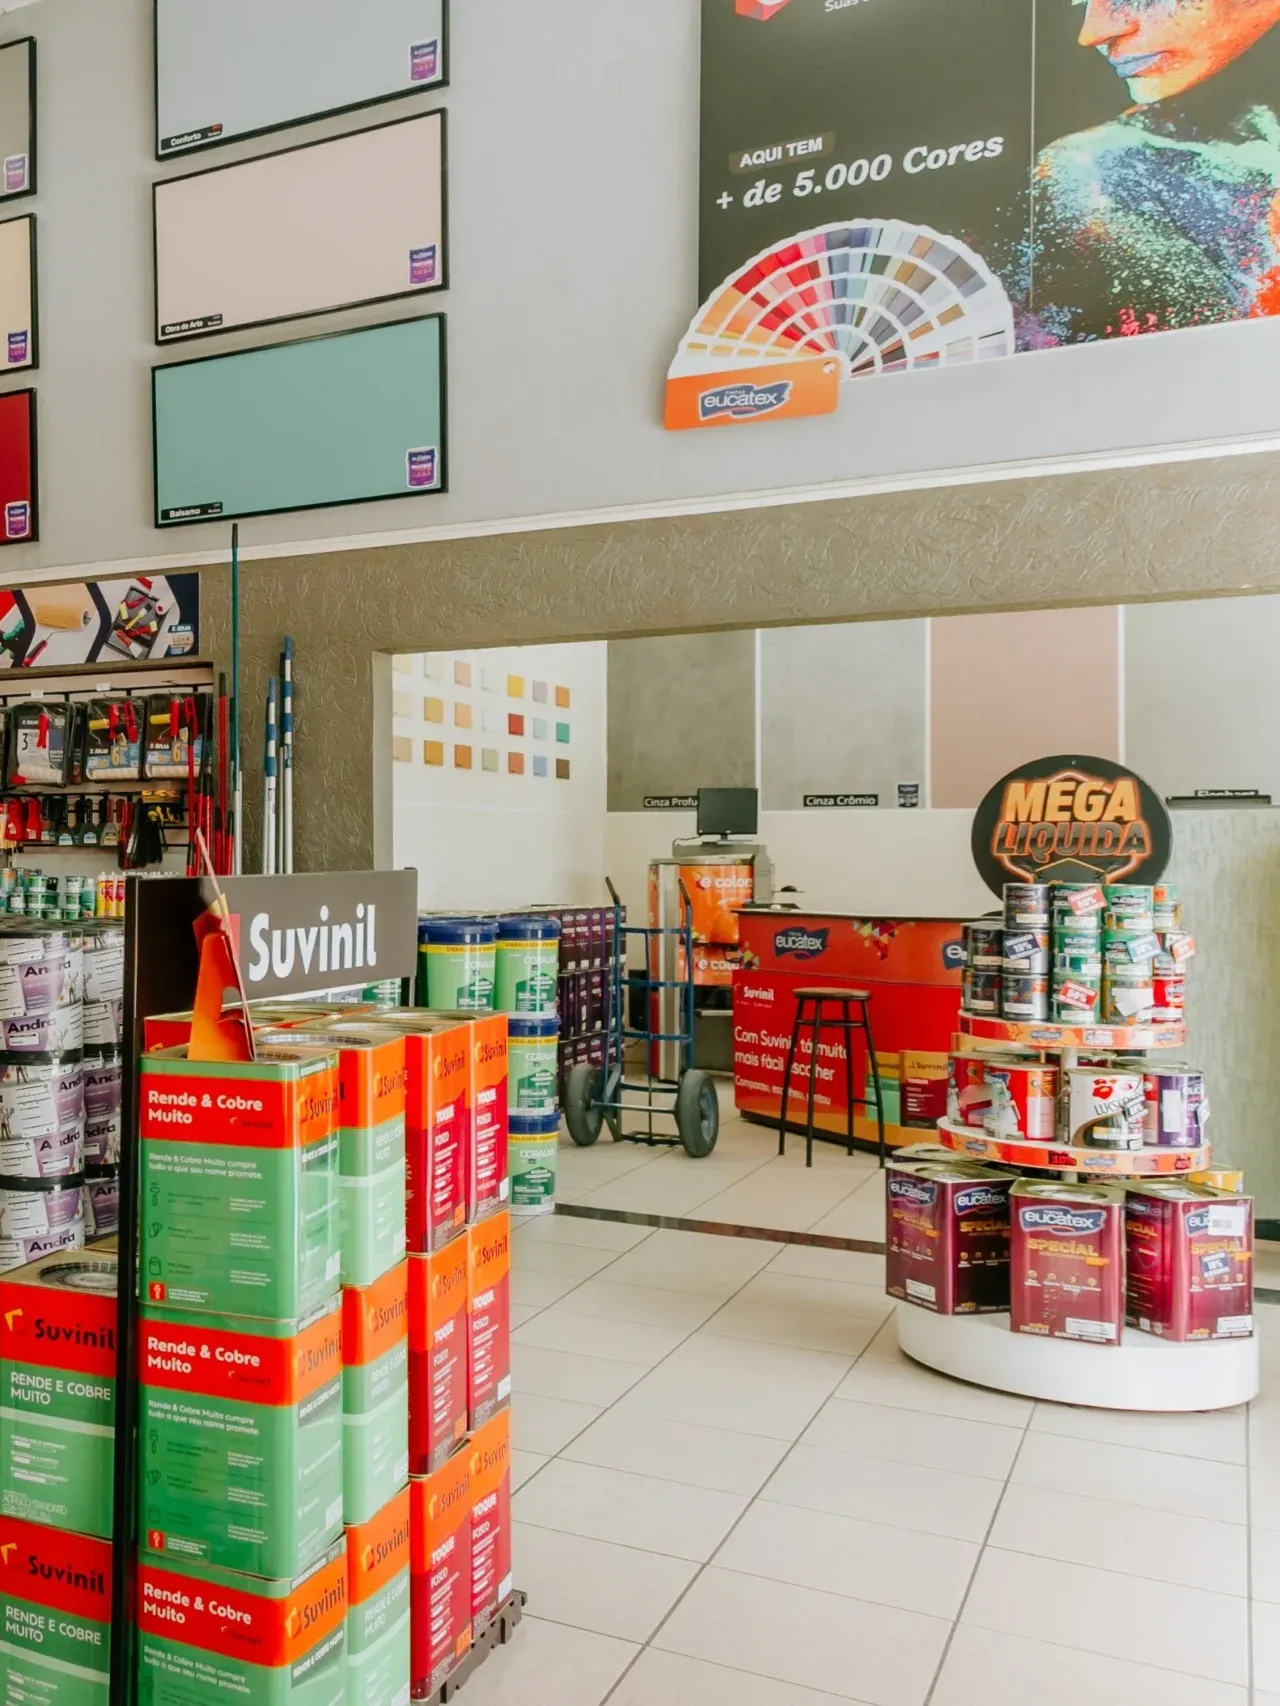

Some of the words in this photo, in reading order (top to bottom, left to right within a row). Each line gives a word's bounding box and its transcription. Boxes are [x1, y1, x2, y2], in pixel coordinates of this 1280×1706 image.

[170, 132, 202, 147] Conforto
[739, 147, 783, 168] AQUI
[785, 137, 824, 158] TEM
[742, 179, 783, 208] de
[792, 153, 893, 198] 5.000
[901, 136, 1005, 175] Cores
[165, 324, 181, 334] Obra
[190, 319, 204, 329] Arte
[704, 390, 779, 409] eucatex
[169, 508, 201, 518] Balsamo
[21, 732, 29, 751] 3
[173, 742, 181, 764] 6
[111, 749, 120, 766] 6
[644, 797, 670, 807] Cinza
[672, 796, 698, 807] Profu
[806, 795, 834, 806] Cinza
[836, 793, 876, 806] Crômio
[1005, 780, 1138, 822] MEGA
[994, 822, 1150, 864] LIQUIDA
[248, 903, 377, 982] Suvinil
[775, 933, 823, 951] eucatex
[744, 985, 774, 1001] Suvinil
[8, 1017, 57, 1035] Andra
[484, 1038, 508, 1063] Suvinil
[734, 1025, 758, 1042] Com
[760, 1029, 797, 1053] Suvini,
[443, 1050, 465, 1078] Suvinil
[734, 1049, 759, 1067] mais
[761, 1053, 784, 1072] fácil
[788, 1061, 835, 1081] scoher
[148, 1089, 197, 1107] Rende
[200, 1094, 213, 1108] &
[217, 1094, 263, 1112] Cobre
[148, 1108, 193, 1125] Muito
[148, 1162, 166, 1171] tudo
[173, 1166, 188, 1174] que
[190, 1167, 204, 1175] seu
[204, 1169, 227, 1177] nome
[228, 1170, 264, 1180] promete.
[149, 1152, 171, 1162] Rende
[180, 1155, 203, 1165] Cobre
[203, 1157, 226, 1167] Muito
[227, 1160, 257, 1170] cumpre
[890, 1181, 932, 1203] eucatex
[957, 1193, 1007, 1207] eucatex
[1024, 1211, 1094, 1229] eucatex
[29, 1232, 76, 1253] Andra
[482, 1235, 508, 1265] Suvinil
[1027, 1237, 1100, 1257] SPECIAL
[440, 1263, 466, 1293] Suvinil
[473, 1290, 495, 1310] TOQUE
[33, 1317, 116, 1352] Suvinil
[434, 1321, 455, 1342] TOQUE
[148, 1336, 197, 1358] Rende
[199, 1344, 211, 1359] &
[214, 1347, 261, 1368] Cobre
[308, 1329, 342, 1372] Suvinil
[148, 1354, 193, 1374] Muito
[9, 1371, 53, 1392] RENDE
[55, 1378, 64, 1393] E
[66, 1379, 112, 1401] COBRE
[10, 1387, 51, 1405] MUITO
[148, 1399, 171, 1410] Rende
[179, 1404, 201, 1416] Cobre
[203, 1408, 224, 1420] Muito
[225, 1413, 255, 1426] cumpre
[439, 1472, 470, 1513] Suvinil
[472, 1493, 497, 1518] TOQUE
[376, 1519, 409, 1564] Suvinil
[431, 1536, 455, 1563] TOQUE
[28, 1555, 106, 1595] Suvinil
[143, 1582, 190, 1607] Rende
[193, 1595, 204, 1611] &
[208, 1599, 252, 1625] Cobre
[143, 1600, 186, 1625] Muito
[303, 1577, 345, 1630] Suvinil
[5, 1604, 45, 1629] RENDE
[48, 1615, 56, 1630] E
[58, 1621, 102, 1647] COBRE
[5, 1622, 44, 1644] MUITO
